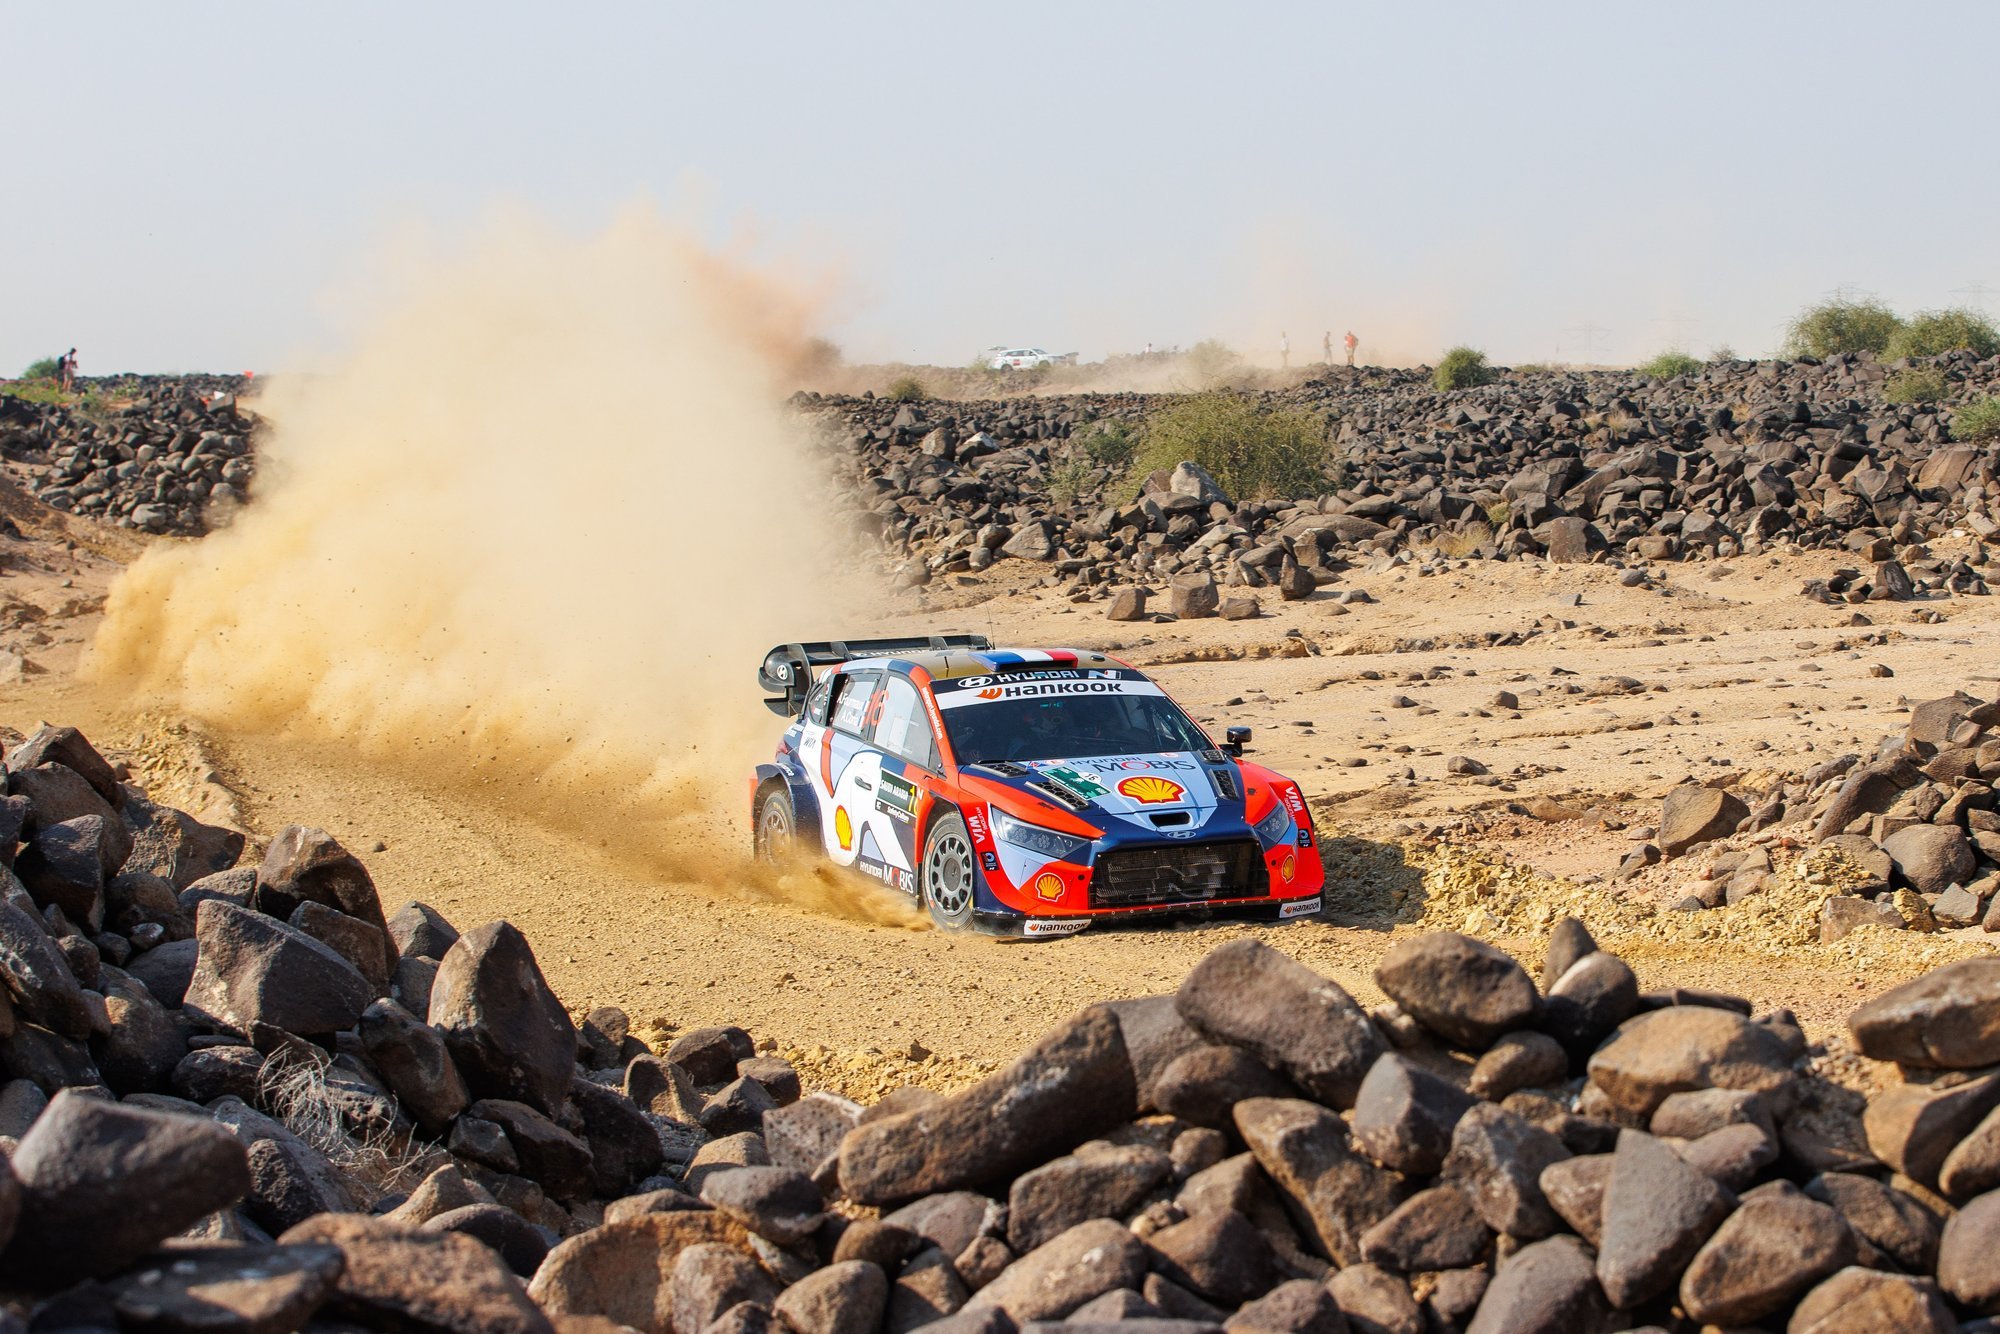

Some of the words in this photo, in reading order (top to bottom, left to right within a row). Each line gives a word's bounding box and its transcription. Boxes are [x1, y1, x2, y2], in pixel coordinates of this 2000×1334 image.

[998, 670, 1080, 683] HYUNDAI
[1070, 756, 1141, 766] HYUNDAI
[1092, 760, 1196, 773] MOBIS
[1085, 773, 1098, 781] 16
[880, 779, 893, 794] SAUDI
[893, 785, 908, 801] ARABIA
[860, 860, 883, 879] HYUNDAI
[883, 864, 914, 894] MOBIS
